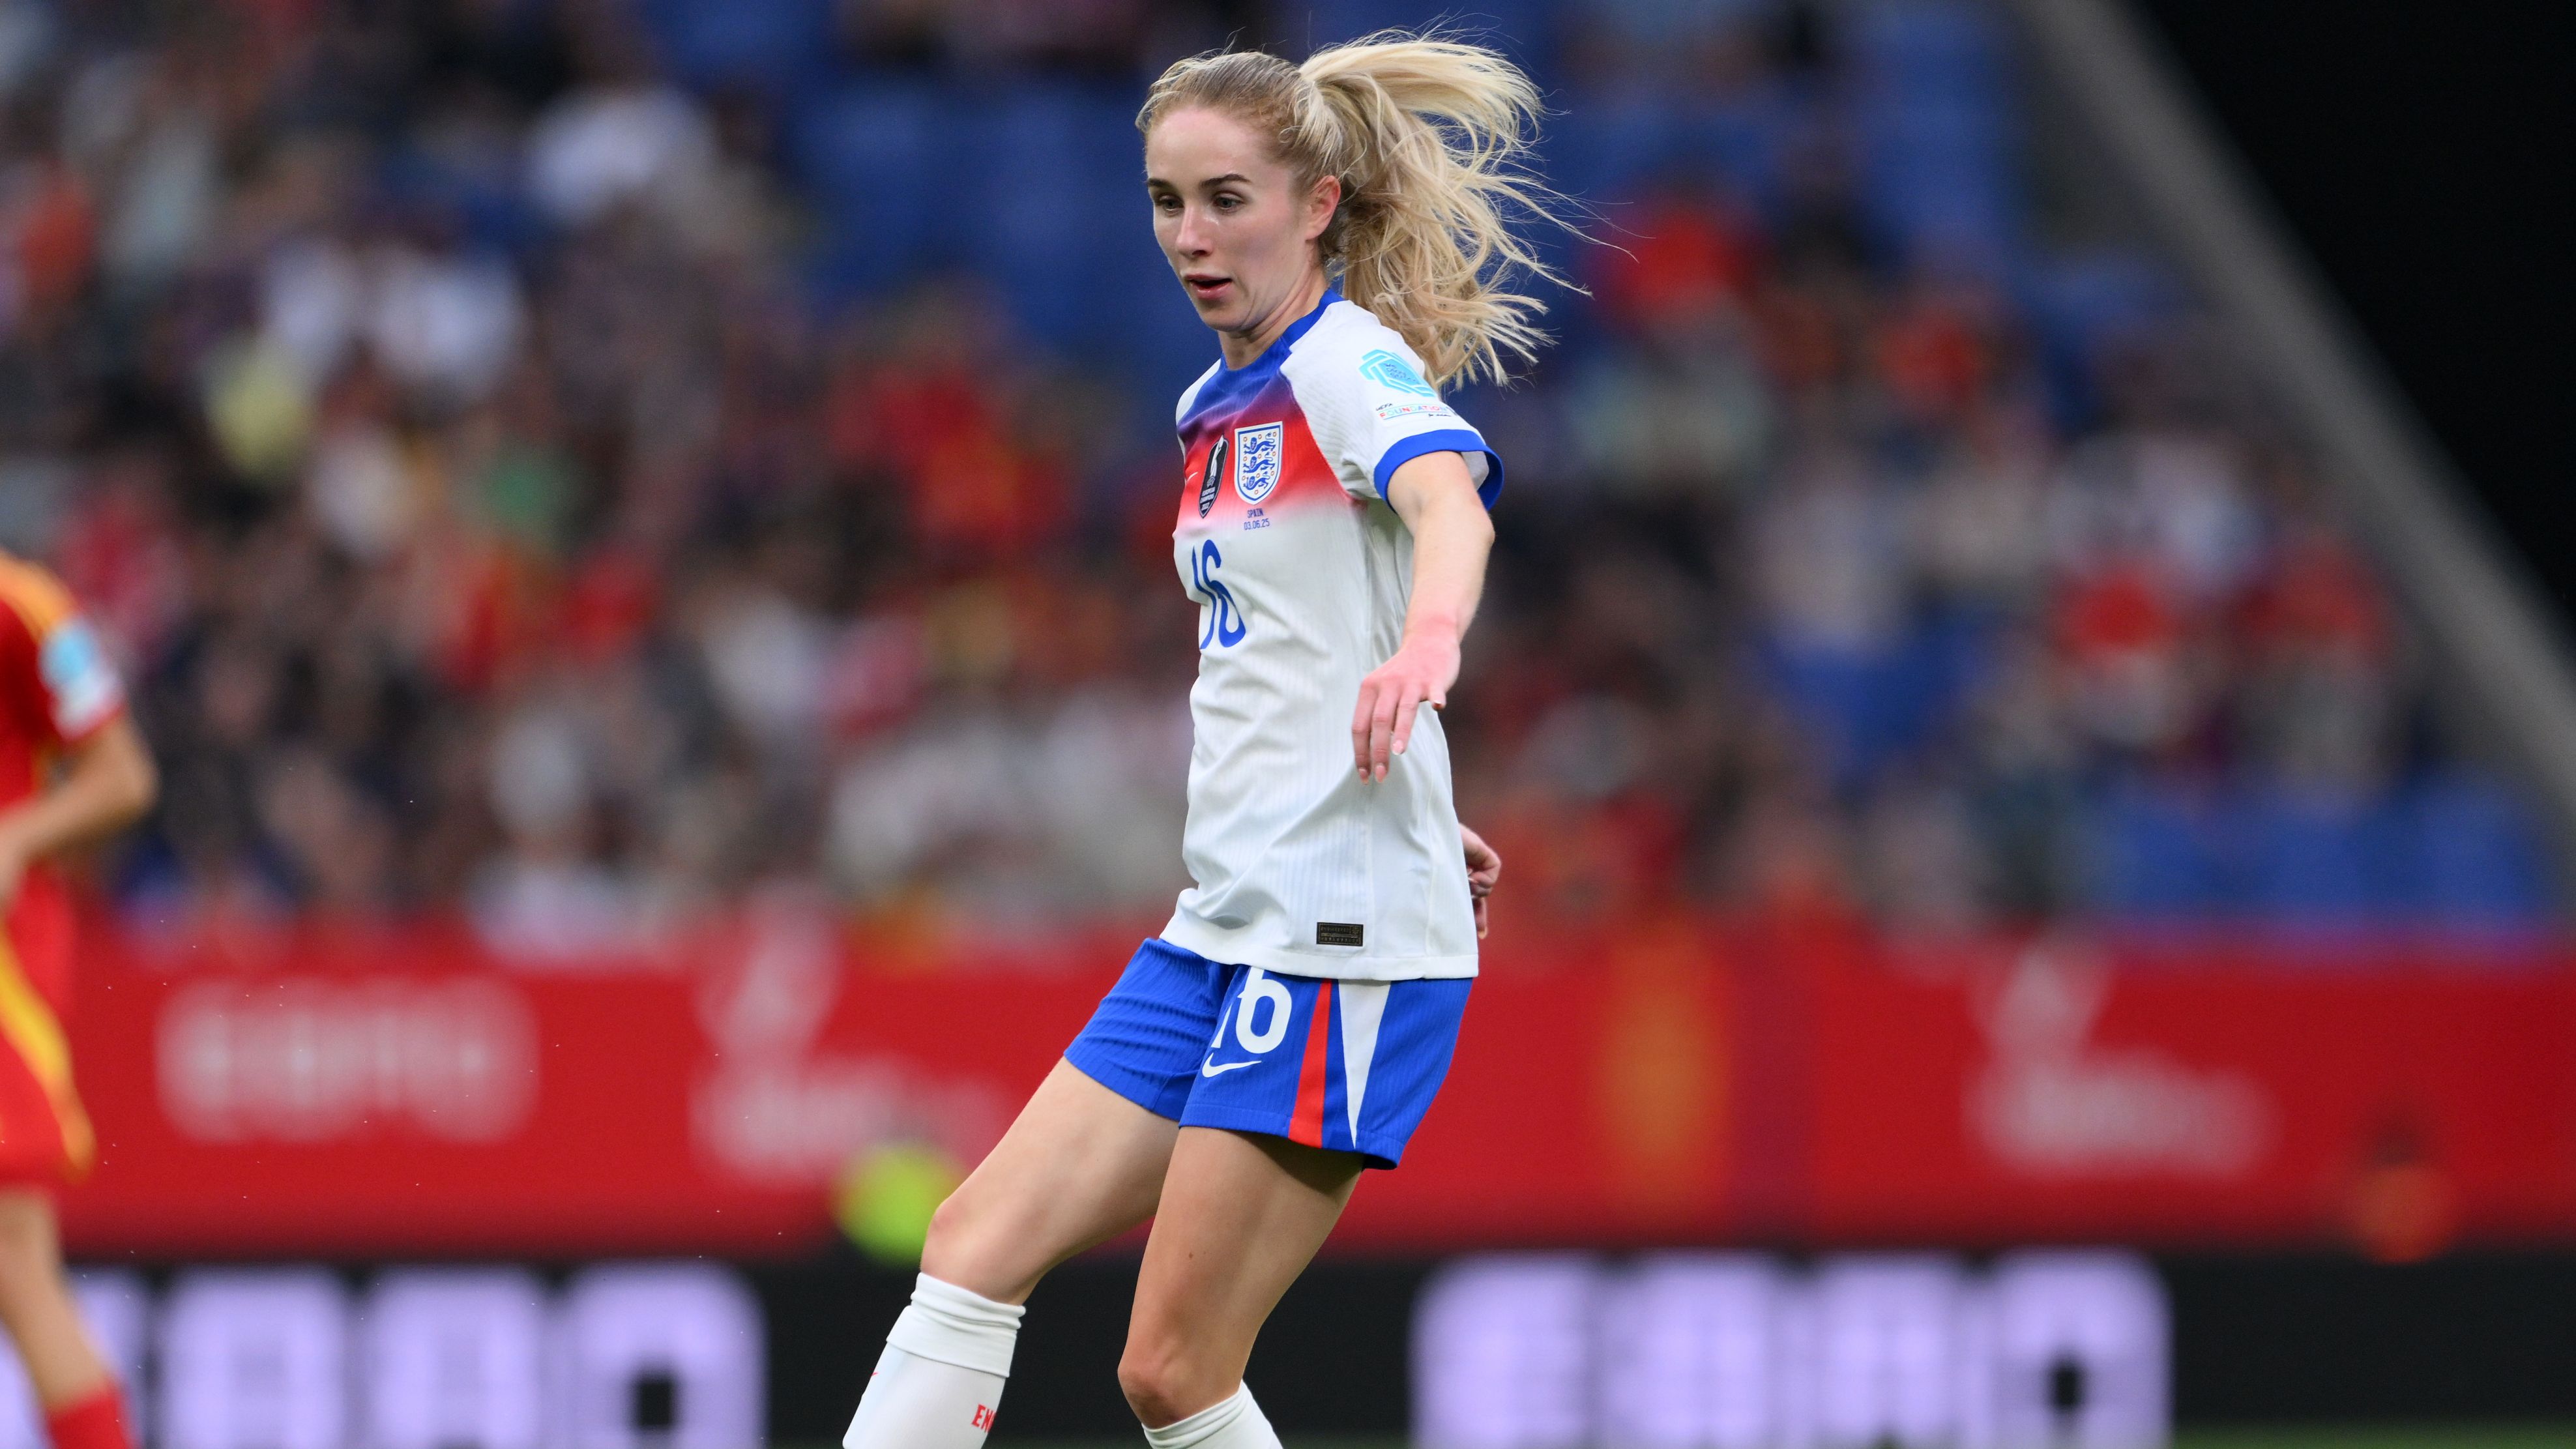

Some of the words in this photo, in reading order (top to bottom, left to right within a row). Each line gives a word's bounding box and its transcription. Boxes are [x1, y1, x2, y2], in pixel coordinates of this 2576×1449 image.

[1247, 508, 1264, 518] SPAIN
[1244, 518, 1270, 531] 03.06.25
[1192, 539, 1246, 649] 16
